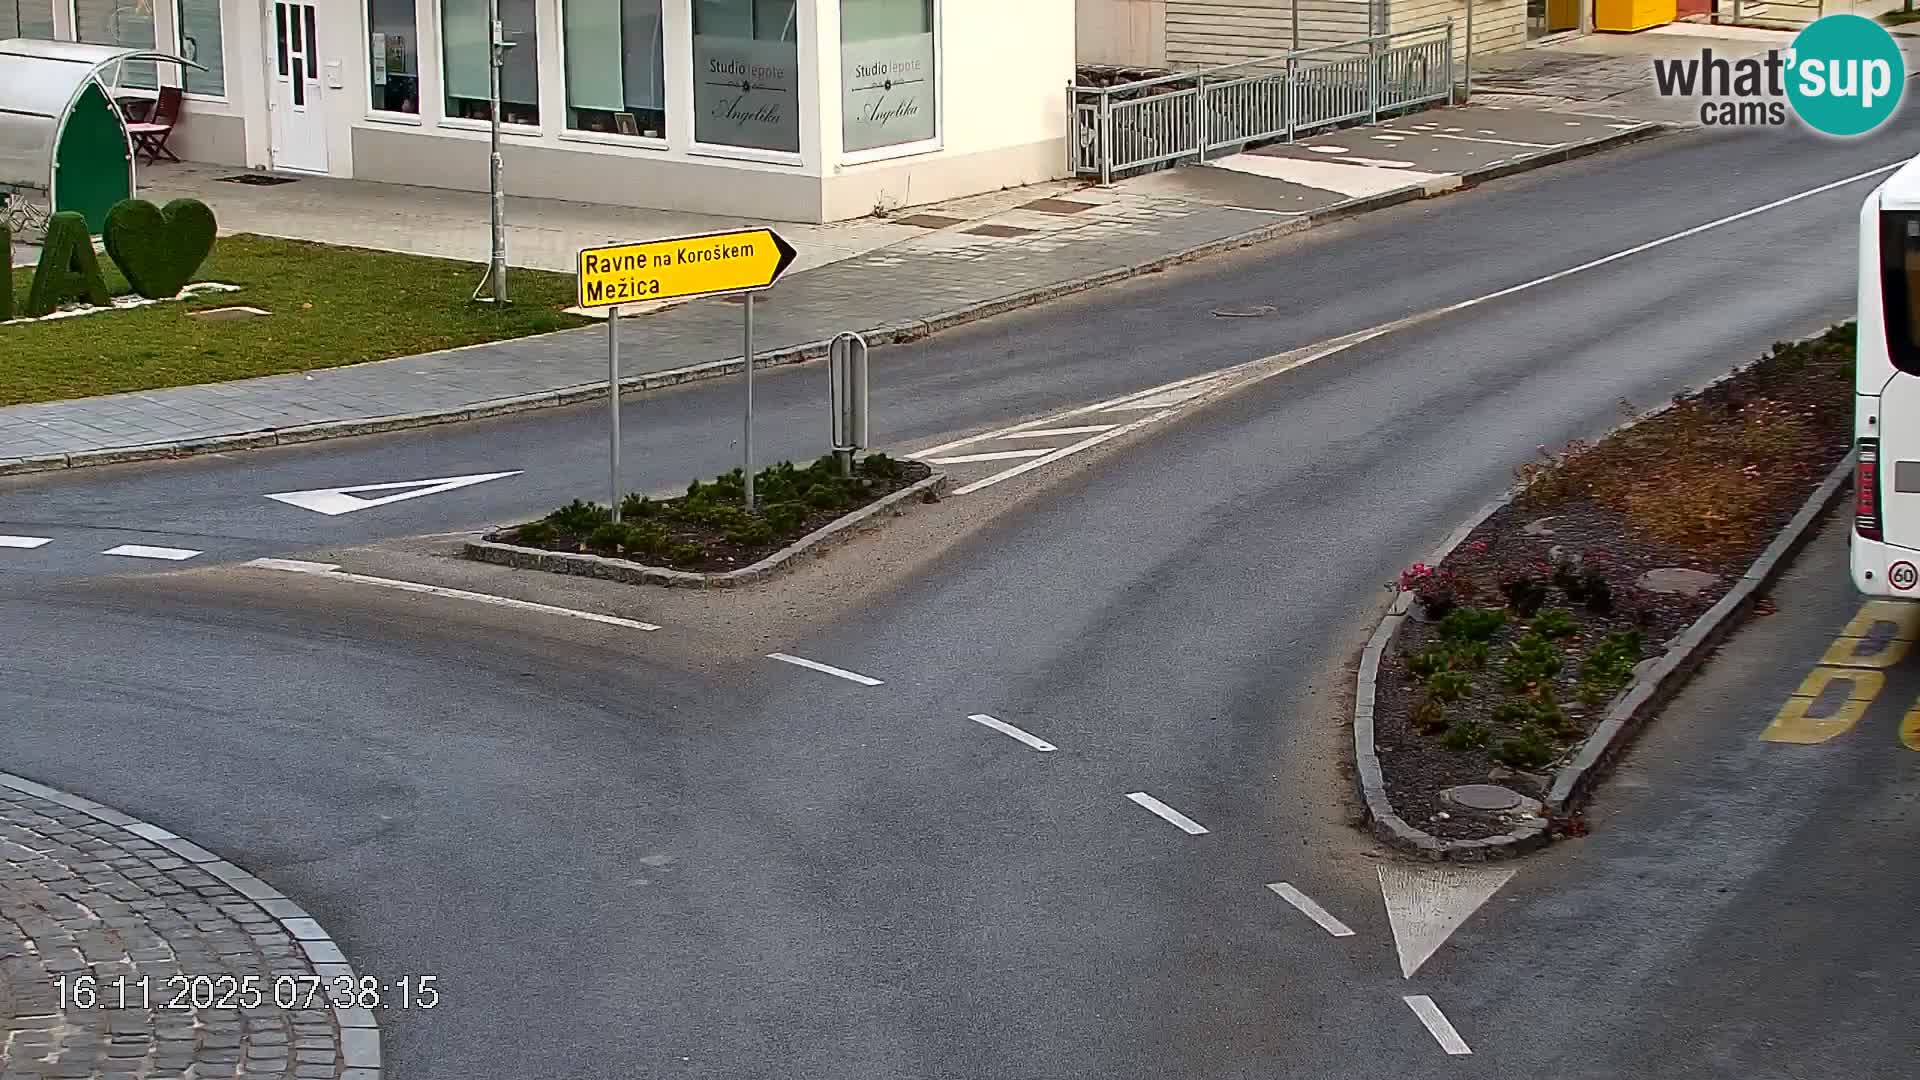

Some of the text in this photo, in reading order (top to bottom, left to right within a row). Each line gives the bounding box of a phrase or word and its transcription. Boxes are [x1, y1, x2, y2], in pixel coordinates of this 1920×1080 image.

[710, 59, 784, 80] Studio lepote
[855, 59, 921, 78] Studio lepote
[711, 96, 780, 126] Angelika
[856, 95, 918, 128] Angelika
[586, 243, 754, 275] Ravne na Koroškem
[586, 278, 660, 302] Mežica
[1894, 568, 1913, 582] 60
